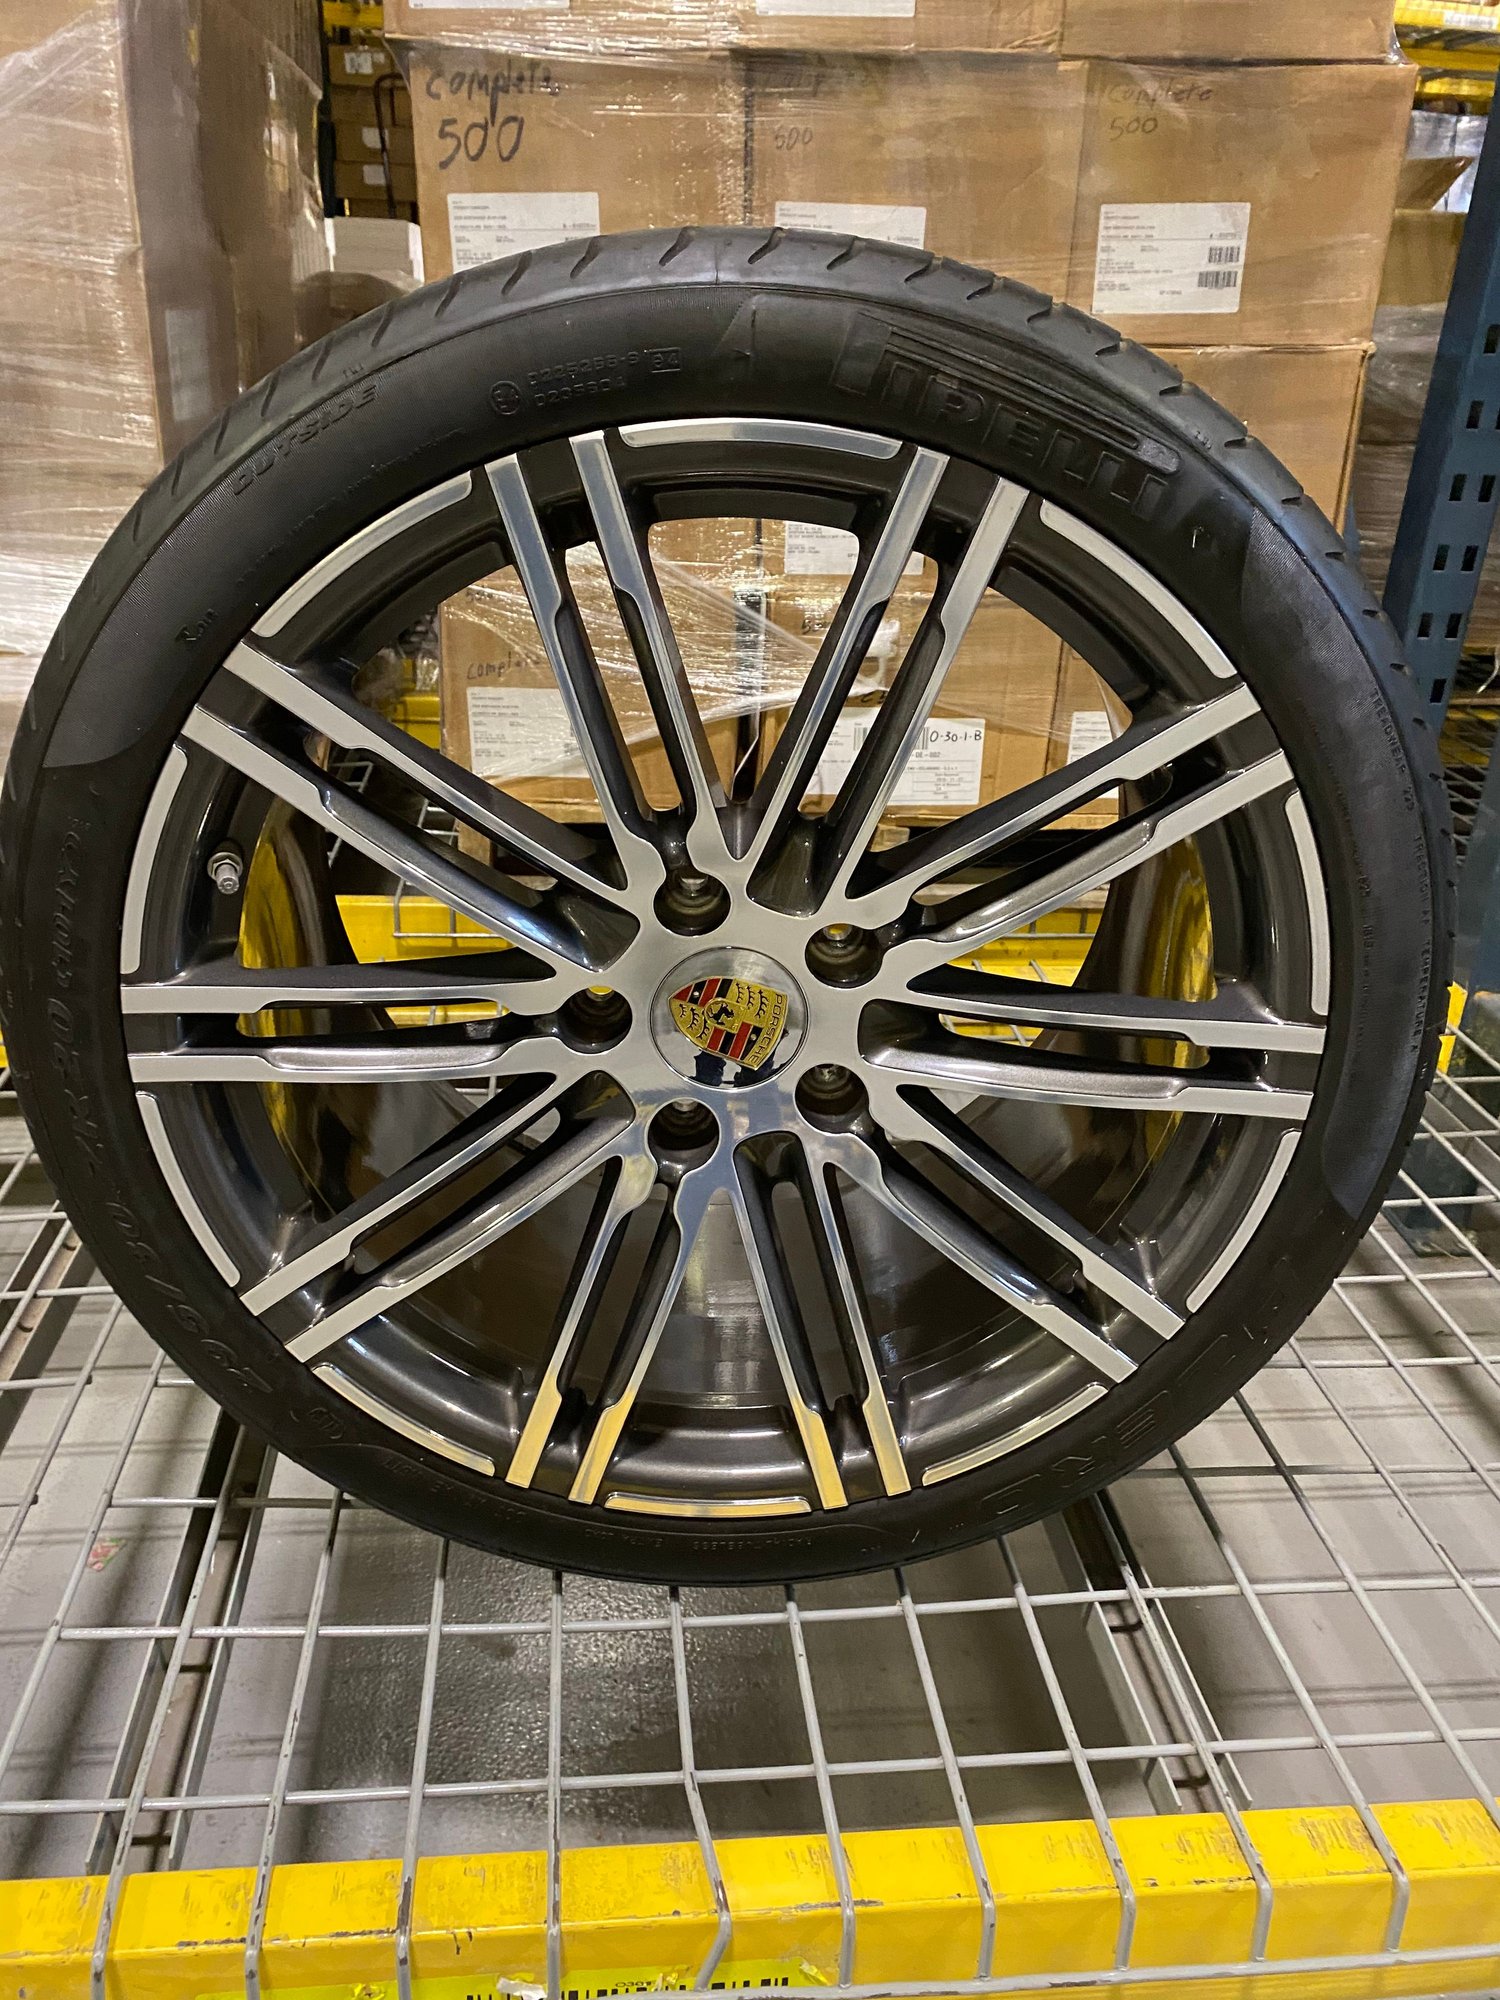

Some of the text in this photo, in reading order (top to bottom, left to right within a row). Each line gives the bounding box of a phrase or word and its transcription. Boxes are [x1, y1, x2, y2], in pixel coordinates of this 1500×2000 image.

[438, 115, 525, 170] 500
[1109, 116, 1158, 142] 500
[231, 382, 379, 496] OUTSIDE
[832, 312, 1180, 521] PIRELLI
[747, 993, 784, 1063] PORSCHE
